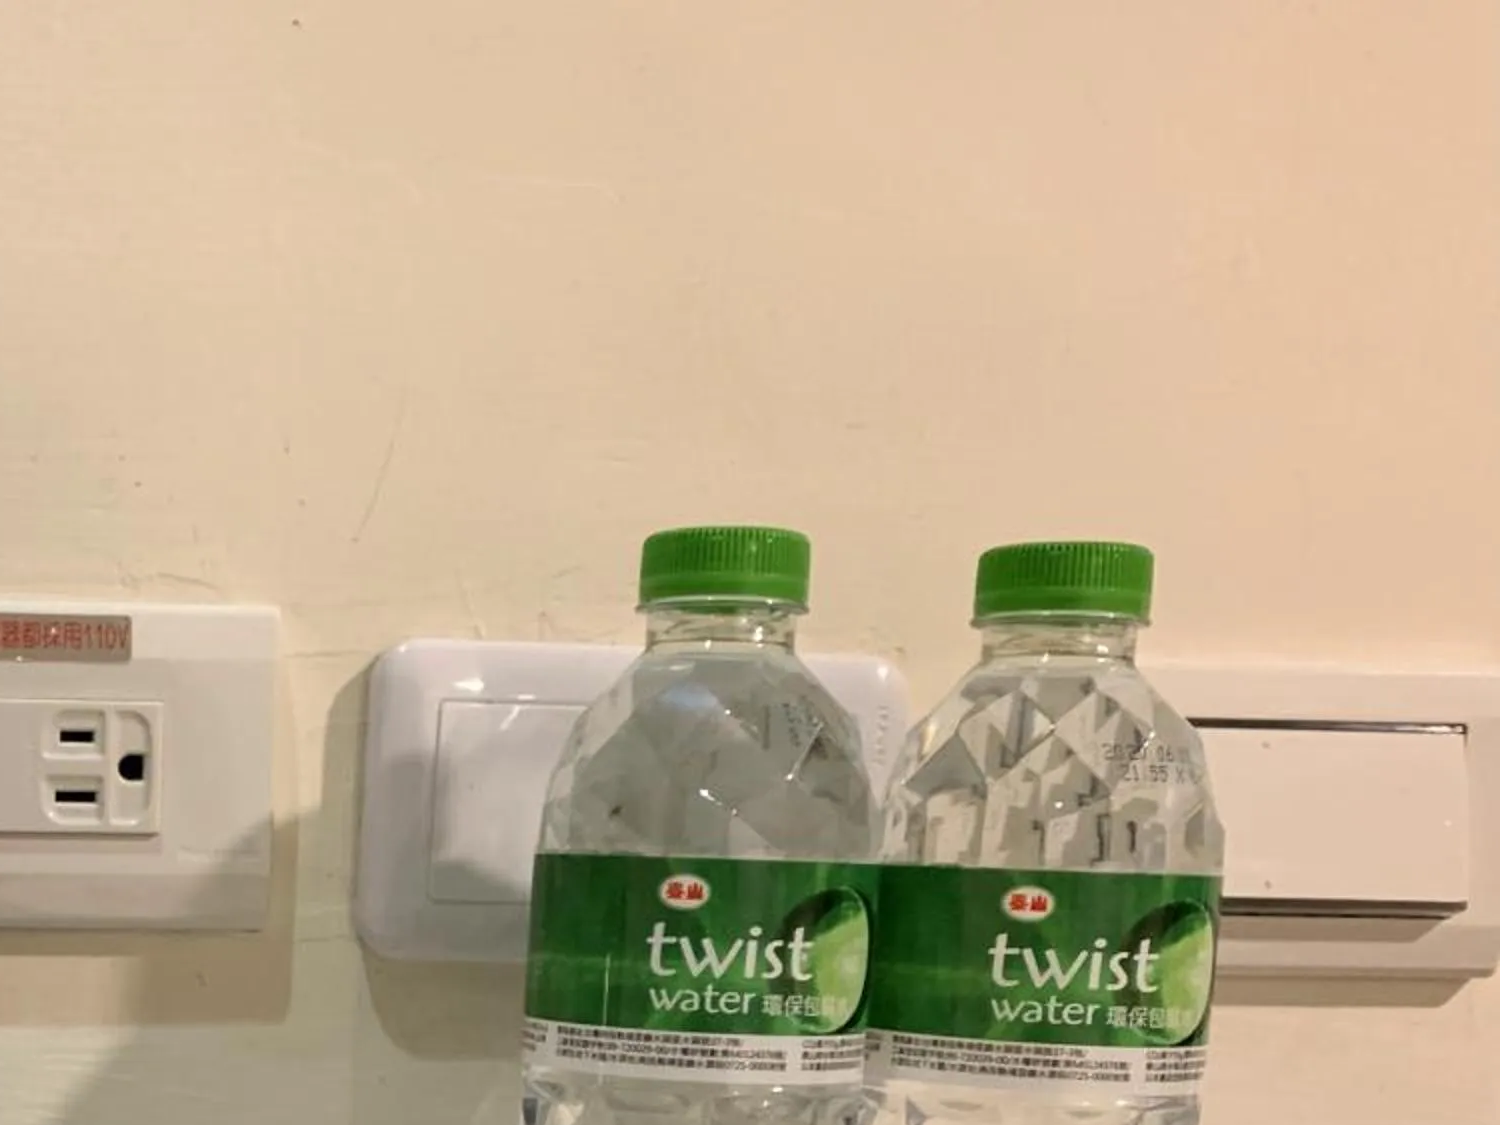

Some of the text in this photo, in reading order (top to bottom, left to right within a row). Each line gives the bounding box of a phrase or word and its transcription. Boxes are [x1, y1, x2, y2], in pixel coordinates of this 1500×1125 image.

[647, 922, 813, 981] twist
[988, 933, 1159, 992] twist
[650, 984, 756, 1014] water
[991, 995, 1101, 1025] water
